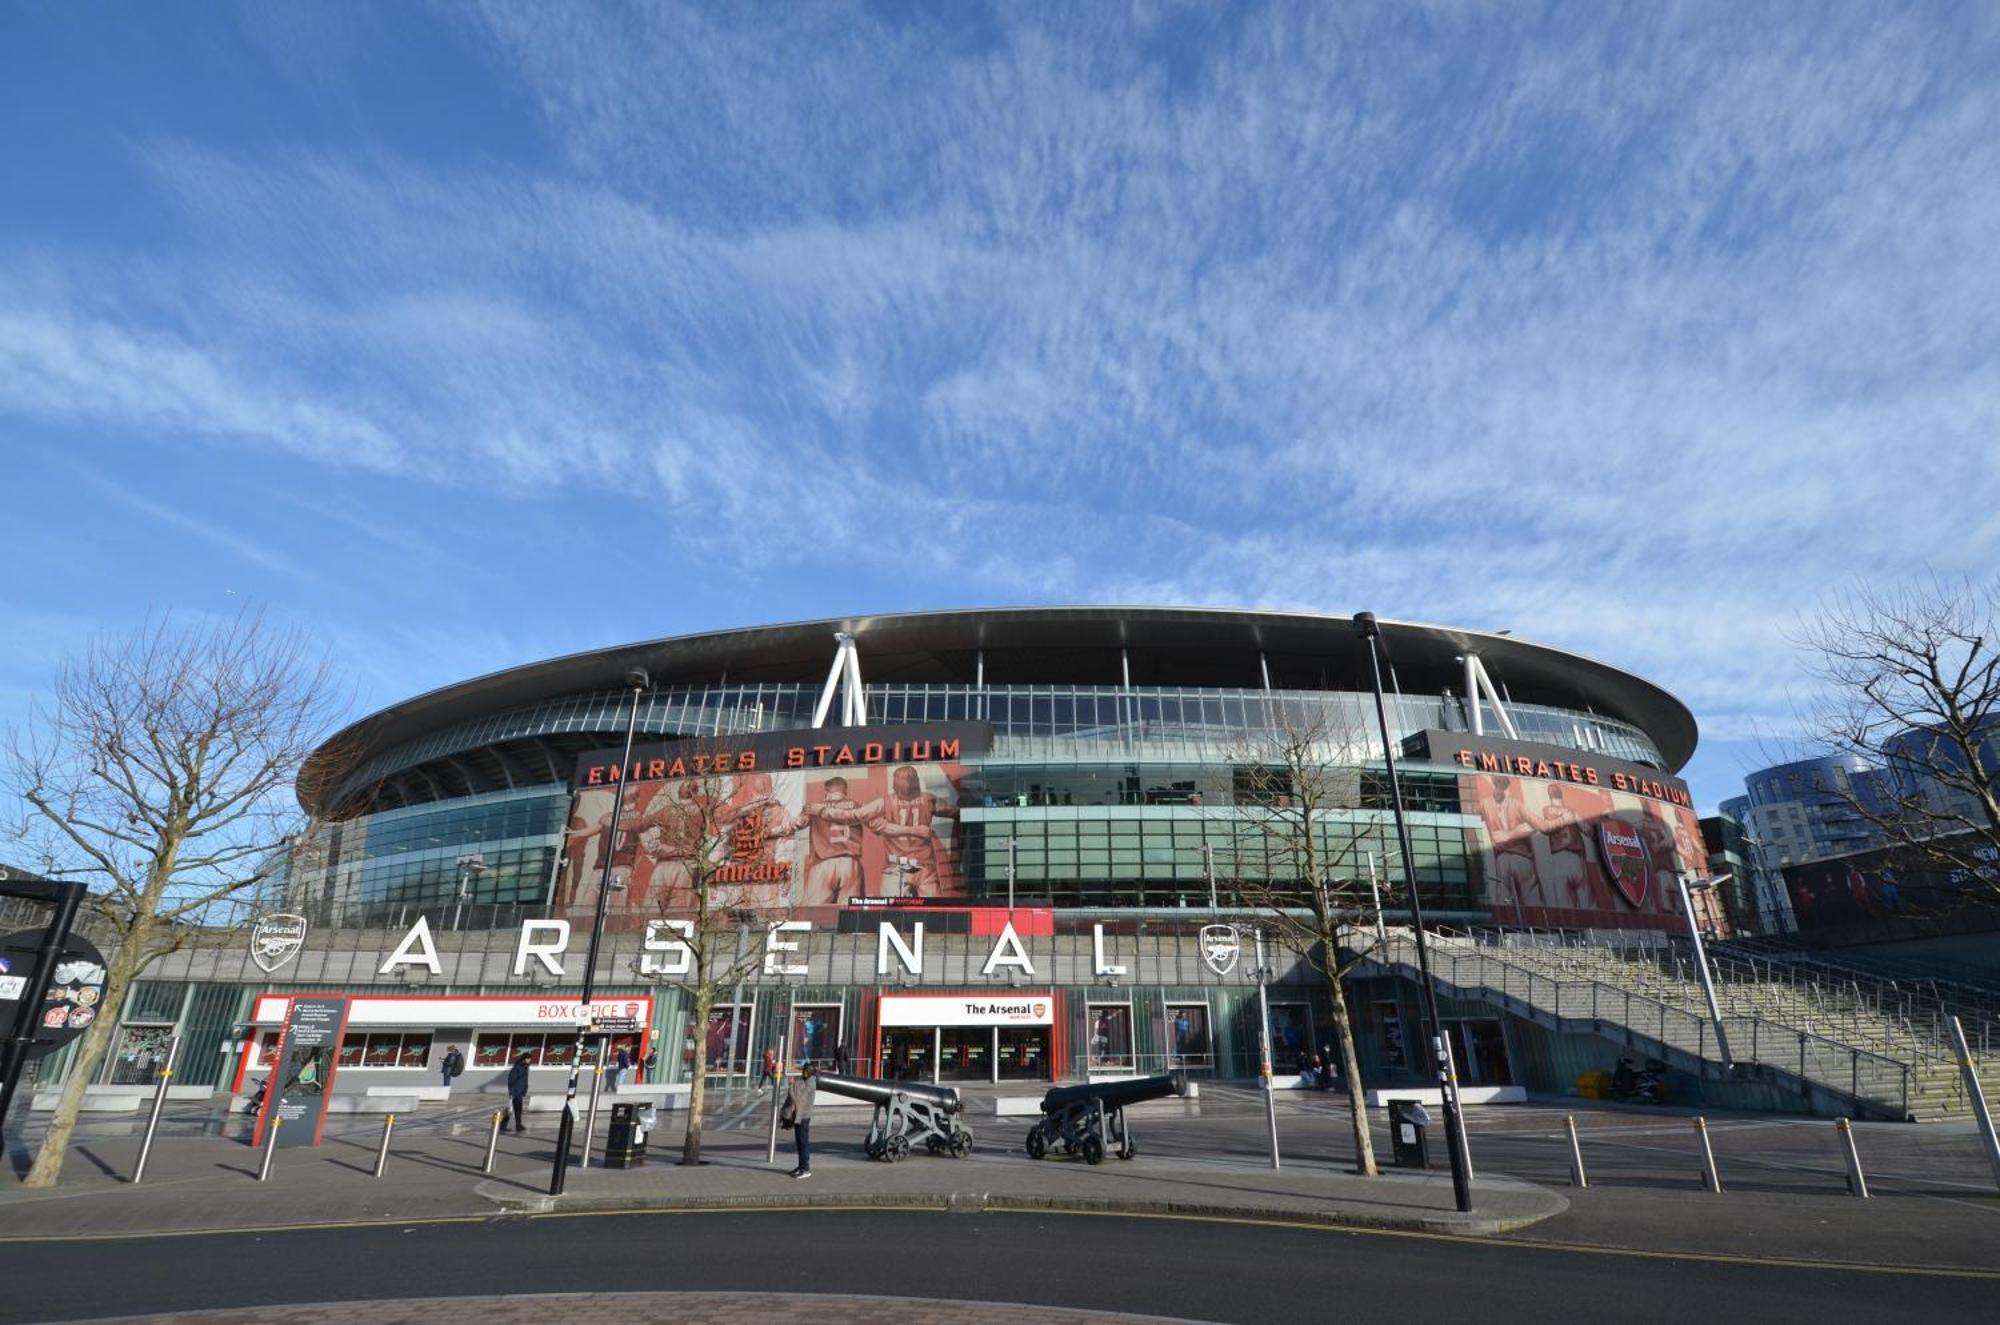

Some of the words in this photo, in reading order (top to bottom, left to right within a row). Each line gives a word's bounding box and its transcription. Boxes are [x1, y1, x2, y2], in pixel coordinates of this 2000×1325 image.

[588, 751, 756, 784] EMIRATES
[787, 738, 960, 767] STADIUM
[1458, 750, 1598, 784] EMIRATES
[1614, 772, 1690, 806] STADIUM
[1606, 831, 1641, 848] Arsenal
[260, 925, 301, 935] Arsenal
[379, 915, 1127, 976] ARSENAL
[1206, 934, 1236, 944] Arsenal
[538, 1005, 568, 1018] BOX
[572, 1005, 619, 1017] FICE
[965, 1004, 986, 1014] The
[989, 1003, 1031, 1014] Arsenal
